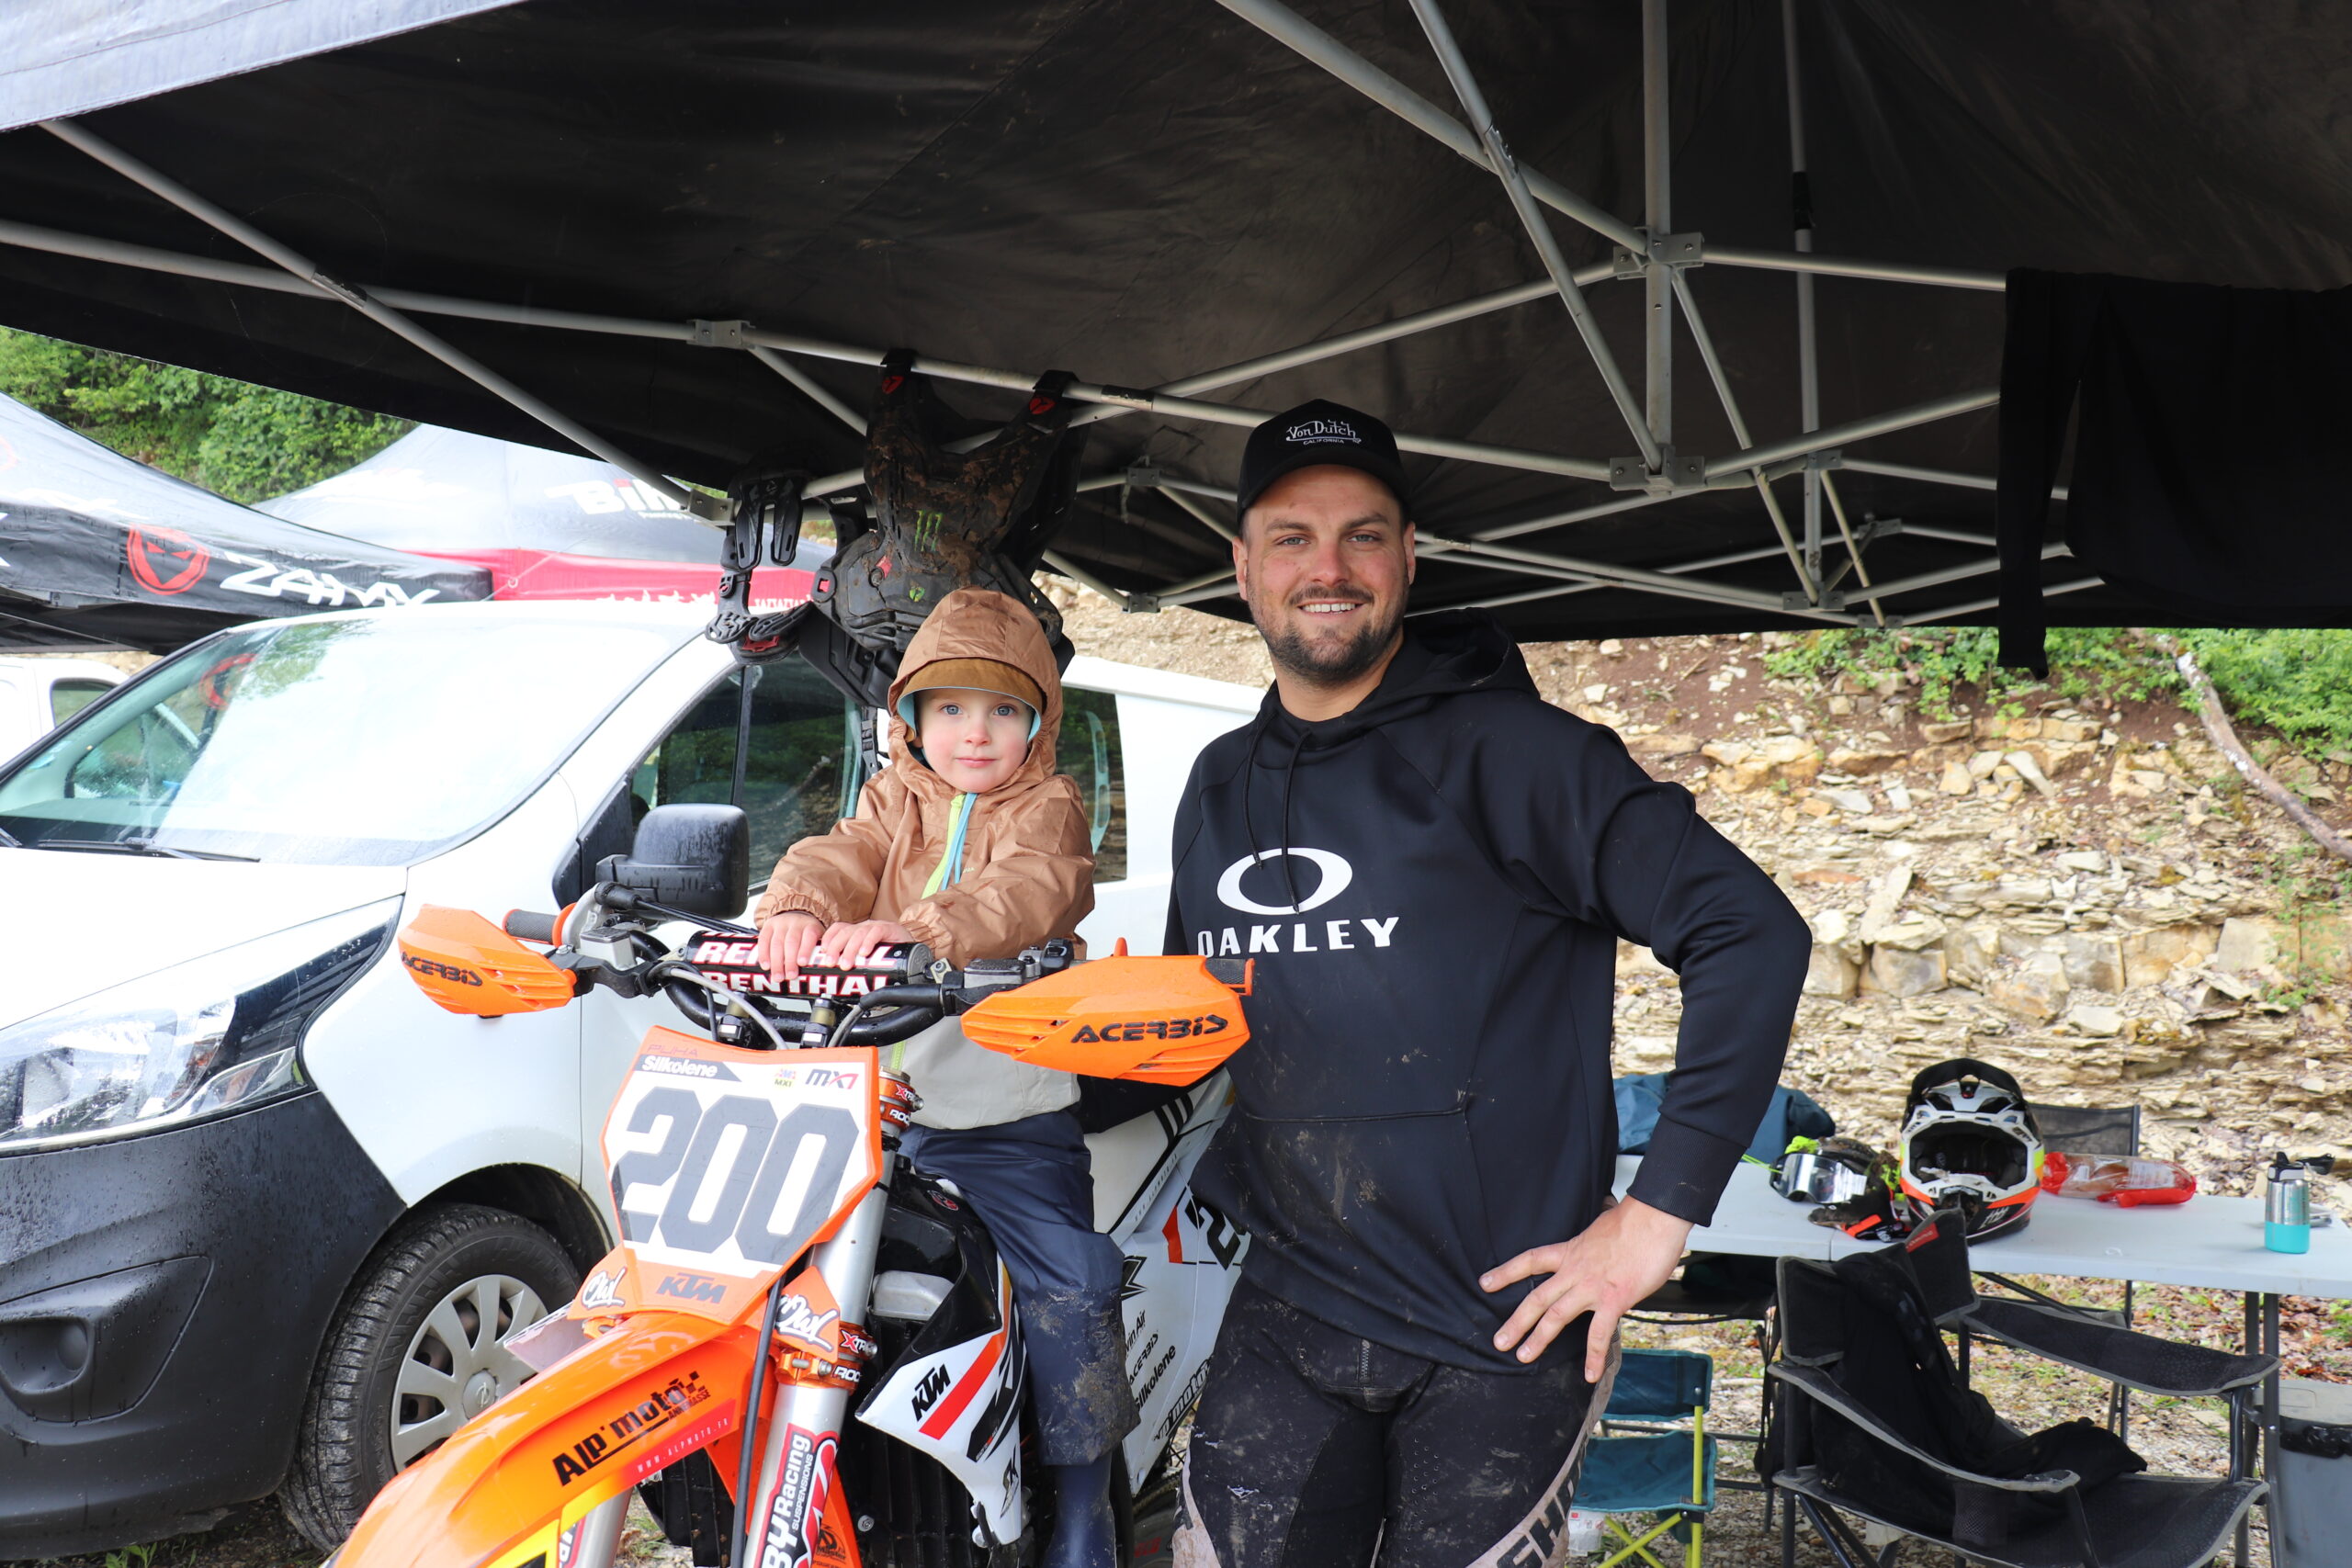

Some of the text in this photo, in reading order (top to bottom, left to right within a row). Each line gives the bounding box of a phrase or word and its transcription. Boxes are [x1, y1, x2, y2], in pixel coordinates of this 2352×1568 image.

[1286, 419, 1357, 439] Von Dutch
[1196, 916, 1400, 958] OAKLEY
[401, 951, 483, 987] ACERBIS
[1070, 1013, 1229, 1044] ACERBIS
[641, 1055, 718, 1078] Silkolene
[611, 1086, 860, 1266] 200
[656, 1272, 729, 1304] KTM
[911, 1363, 951, 1422] KTM
[791, 1453, 814, 1531] SUSPENSIONS
